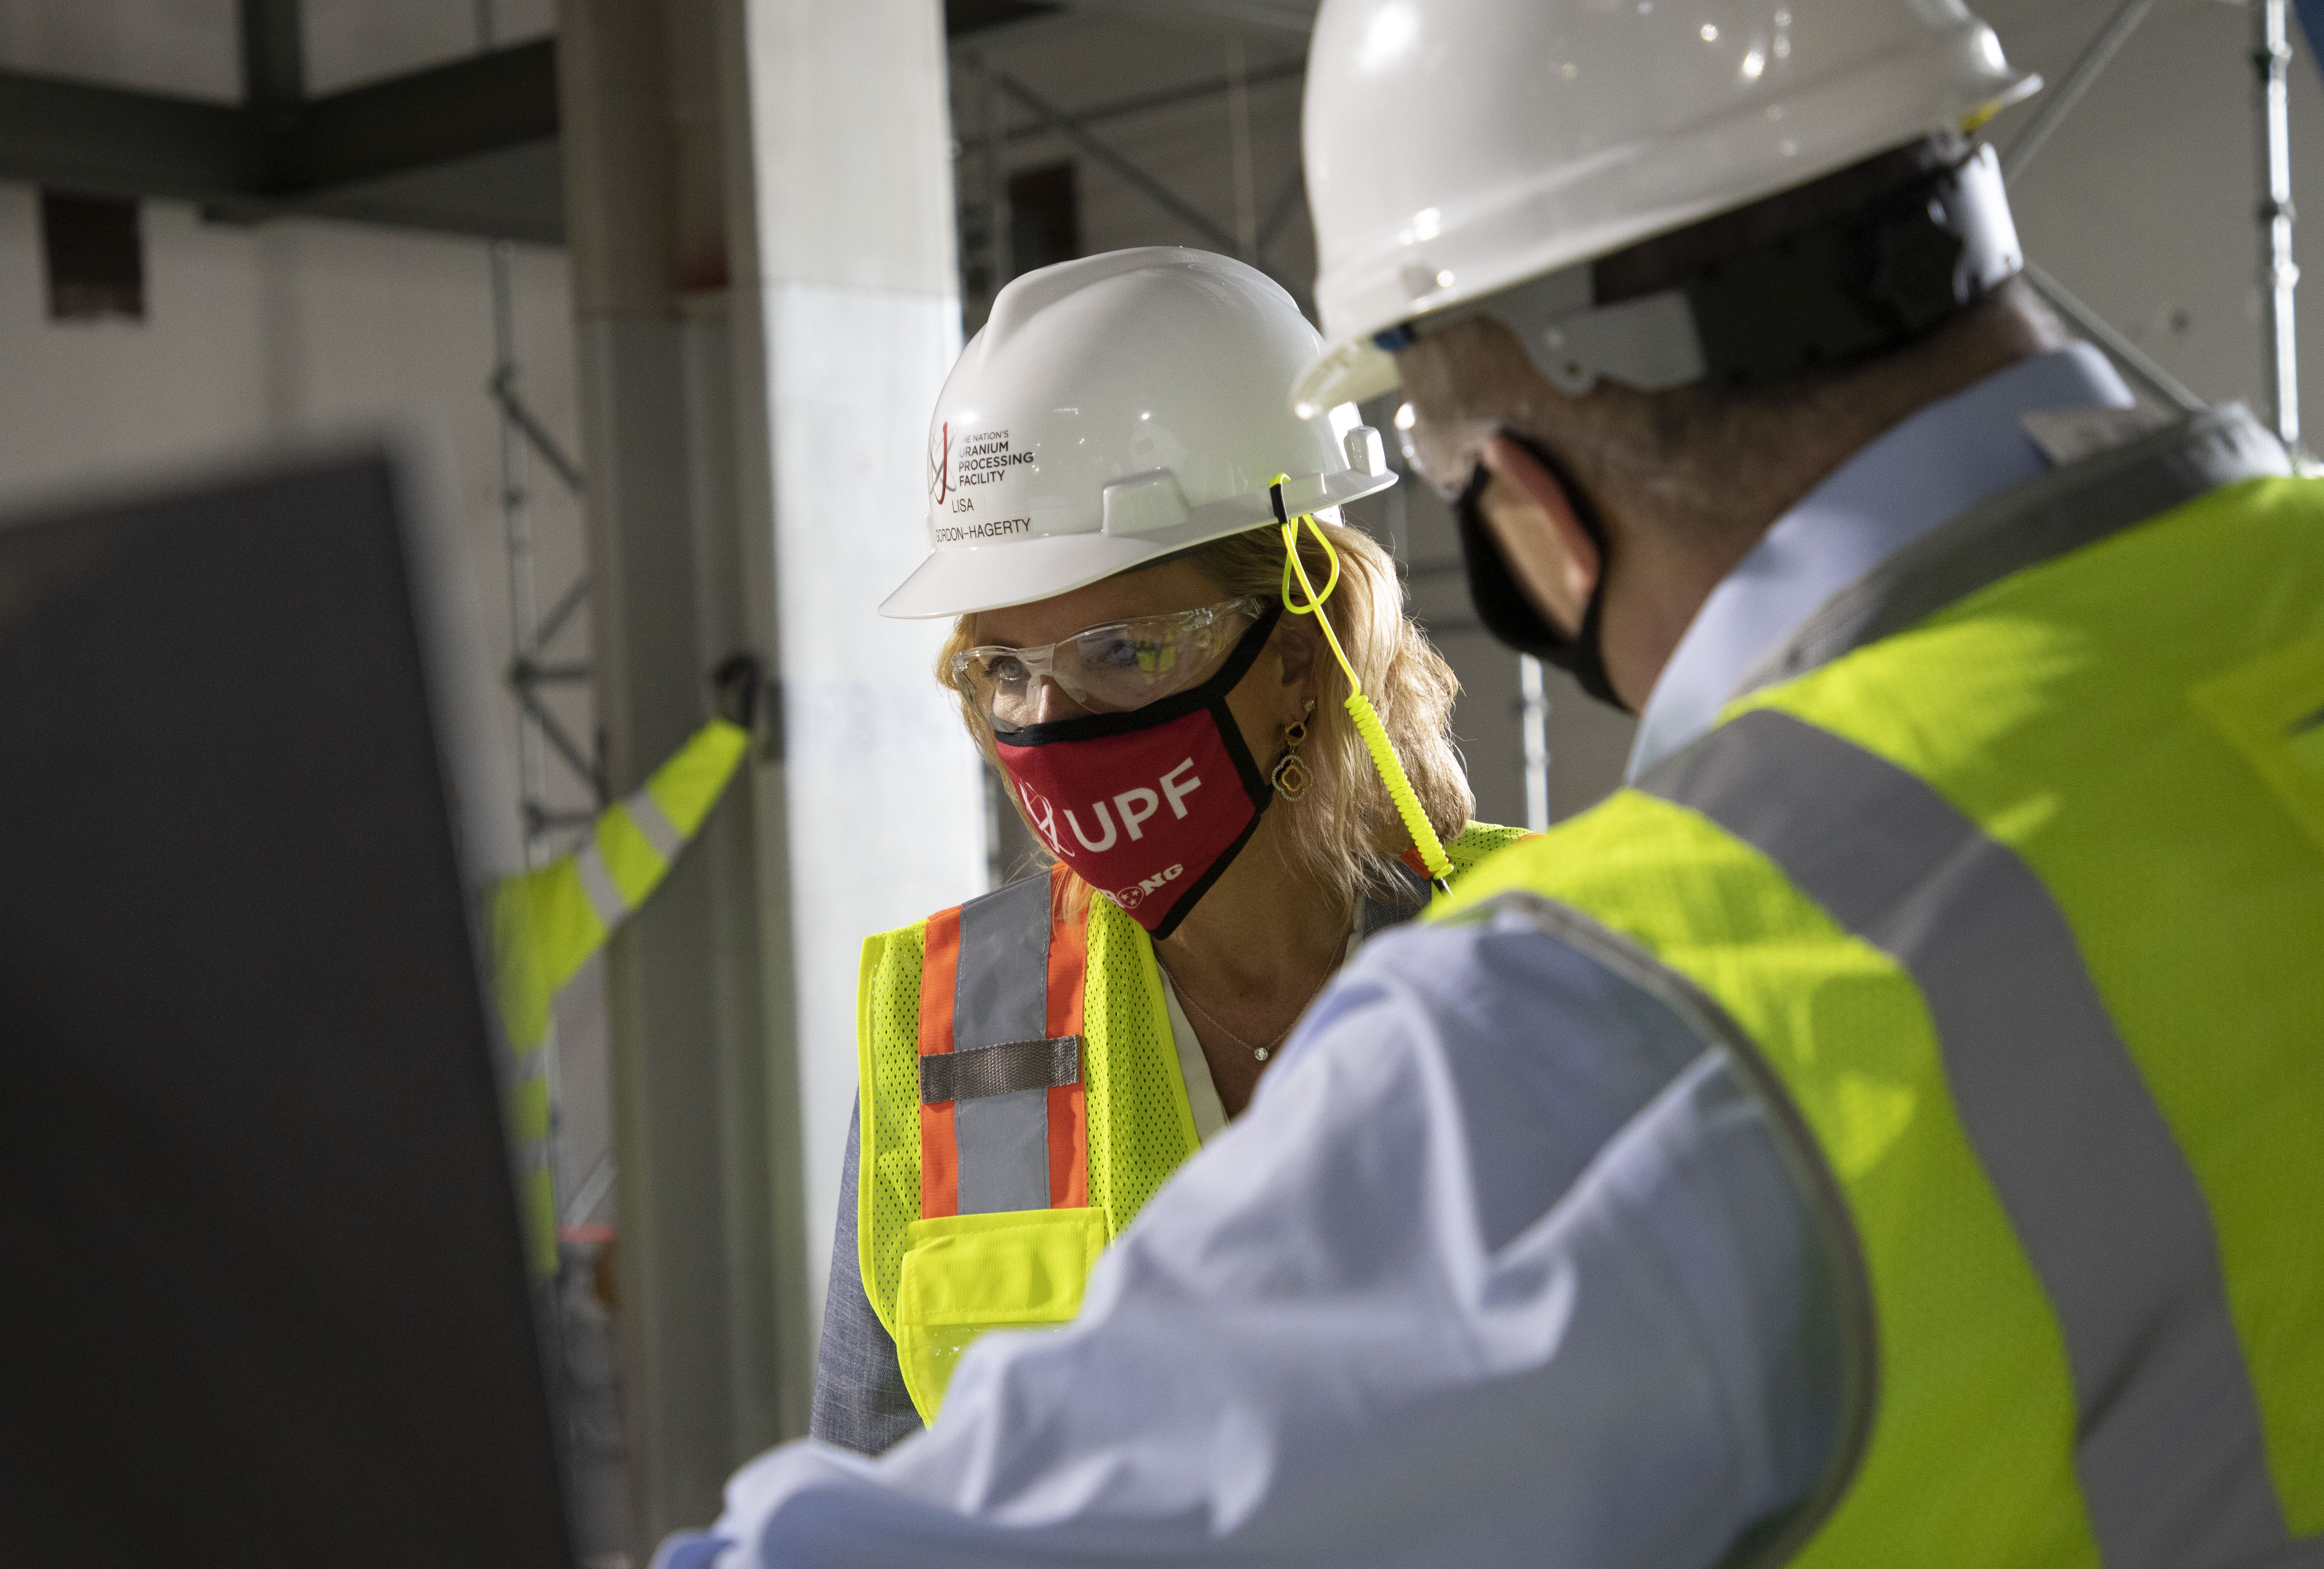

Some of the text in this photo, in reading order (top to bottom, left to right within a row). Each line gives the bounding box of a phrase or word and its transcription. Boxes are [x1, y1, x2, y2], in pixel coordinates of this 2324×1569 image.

[959, 430, 1009, 443] THE NATION'S
[959, 440, 1009, 458] URANIUM
[958, 452, 1034, 472] PROCESSING
[959, 469, 1005, 487] FACILITY
[952, 498, 975, 513] LISA
[935, 517, 1031, 543] GORDON-HAGERTY
[1062, 756, 1202, 853] UPF
